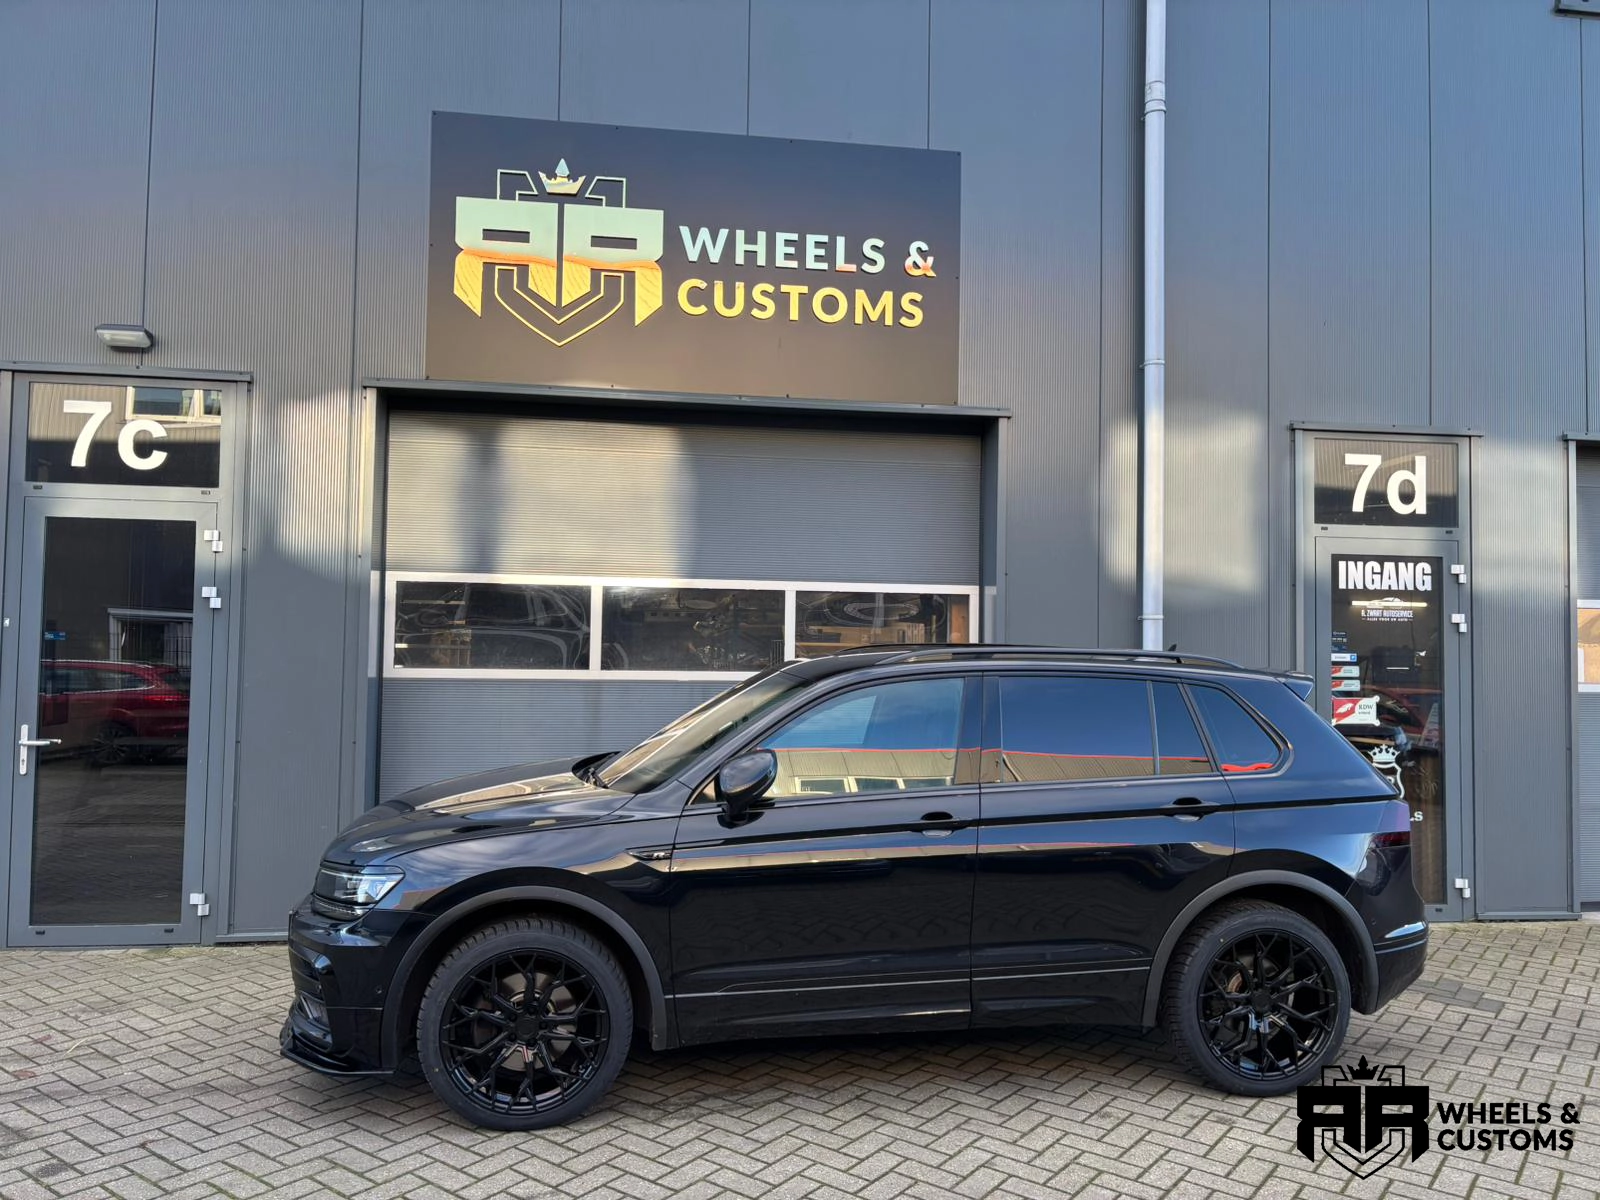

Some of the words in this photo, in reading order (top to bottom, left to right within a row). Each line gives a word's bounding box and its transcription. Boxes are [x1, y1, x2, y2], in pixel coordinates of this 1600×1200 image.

[678, 225, 886, 274] WHEELS
[904, 240, 937, 278] &
[676, 277, 925, 329] CUSTOMS
[62, 399, 169, 471] 7c
[1344, 453, 1427, 515] 7d
[1338, 560, 1433, 592] INGANG
